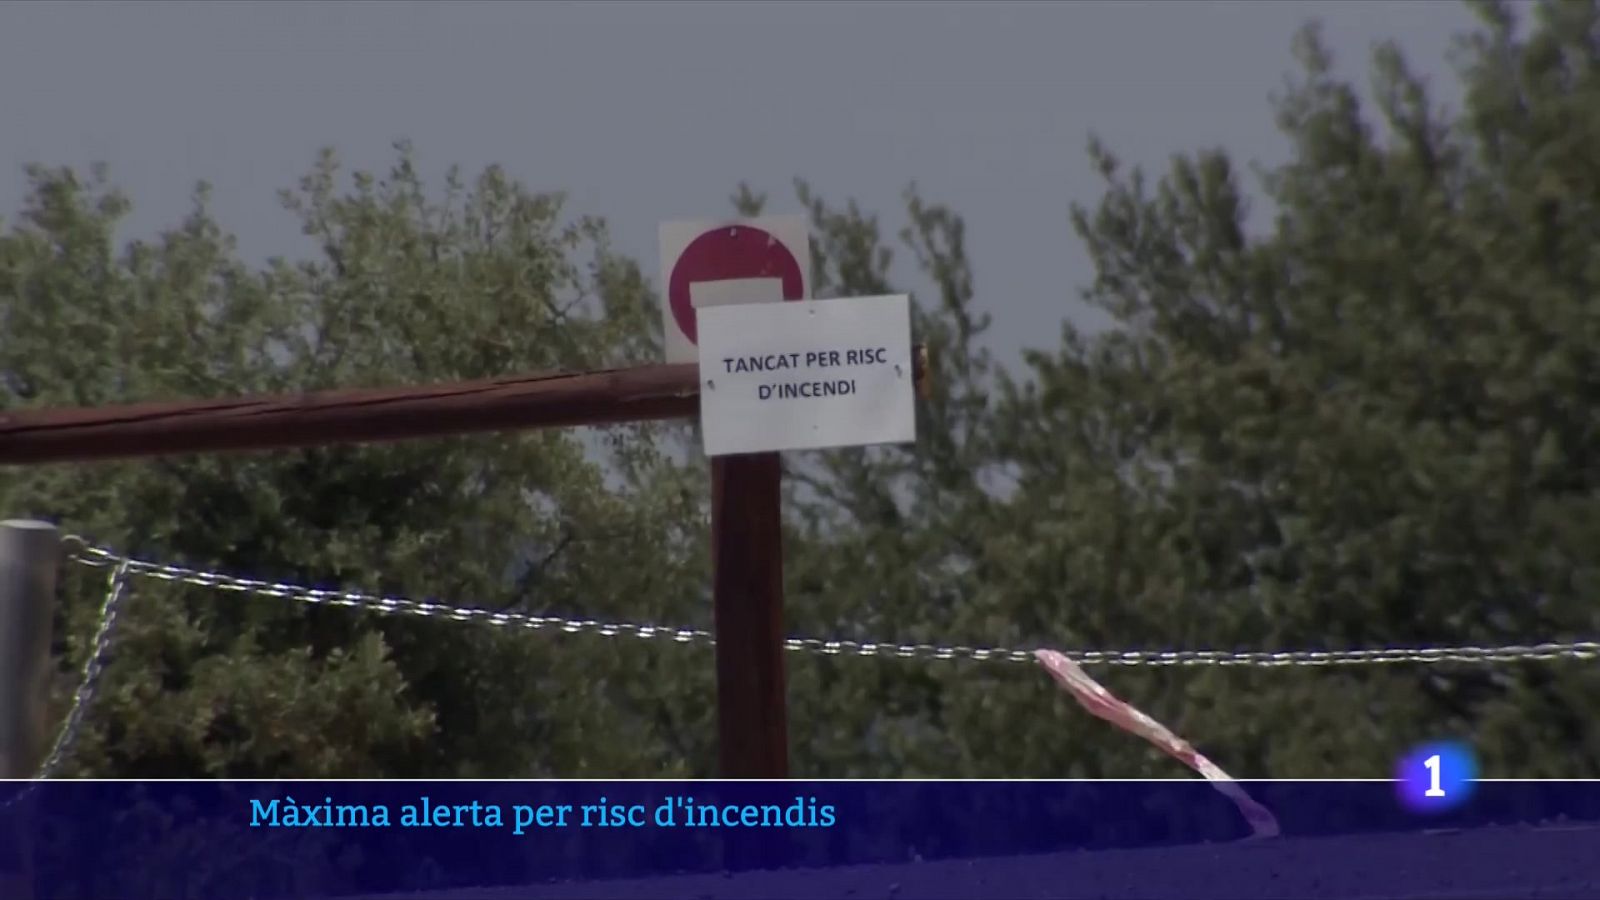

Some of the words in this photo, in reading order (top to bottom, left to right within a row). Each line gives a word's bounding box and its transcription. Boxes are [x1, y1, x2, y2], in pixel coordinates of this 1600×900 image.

[722, 353, 801, 374] TANCAT
[805, 350, 841, 368] PER
[846, 347, 888, 366] RISC
[757, 379, 857, 401] D’INCENDI
